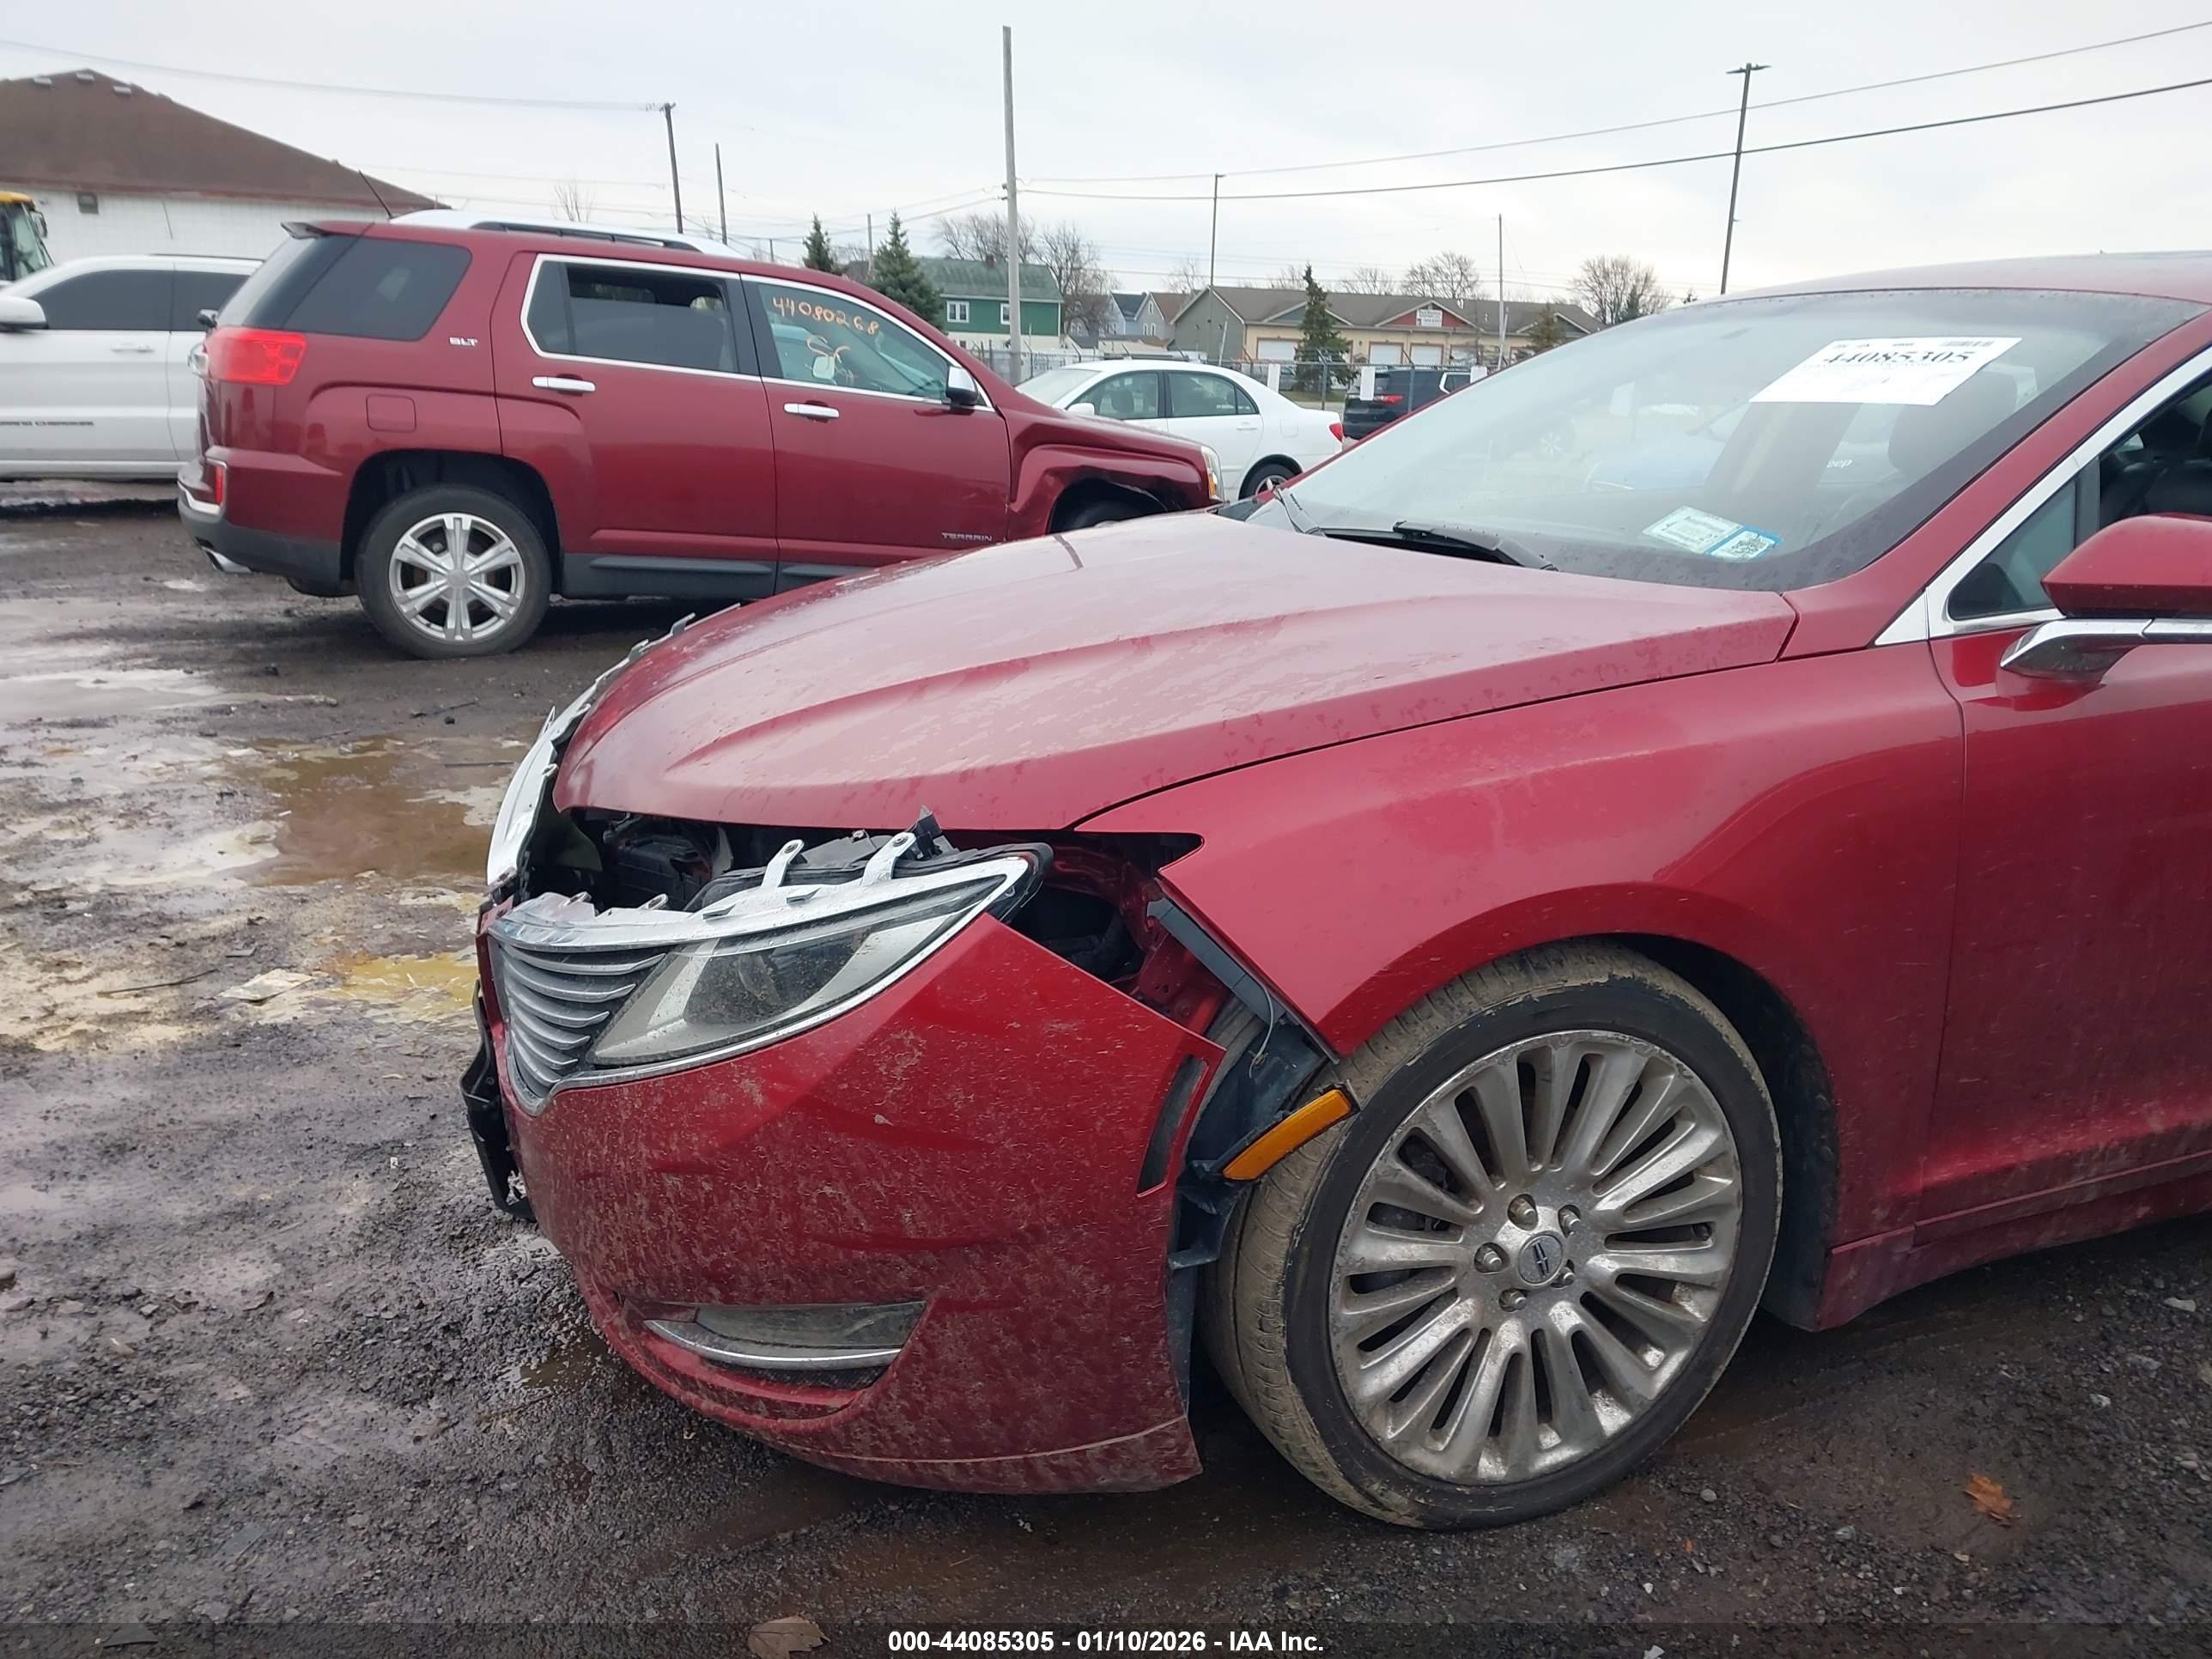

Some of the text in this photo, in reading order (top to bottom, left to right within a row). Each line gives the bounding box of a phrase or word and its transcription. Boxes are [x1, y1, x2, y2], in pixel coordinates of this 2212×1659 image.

[773, 296, 880, 335] 44080268
[1823, 351, 1977, 363] 44085305
[941, 532, 993, 542] TERRAIN
